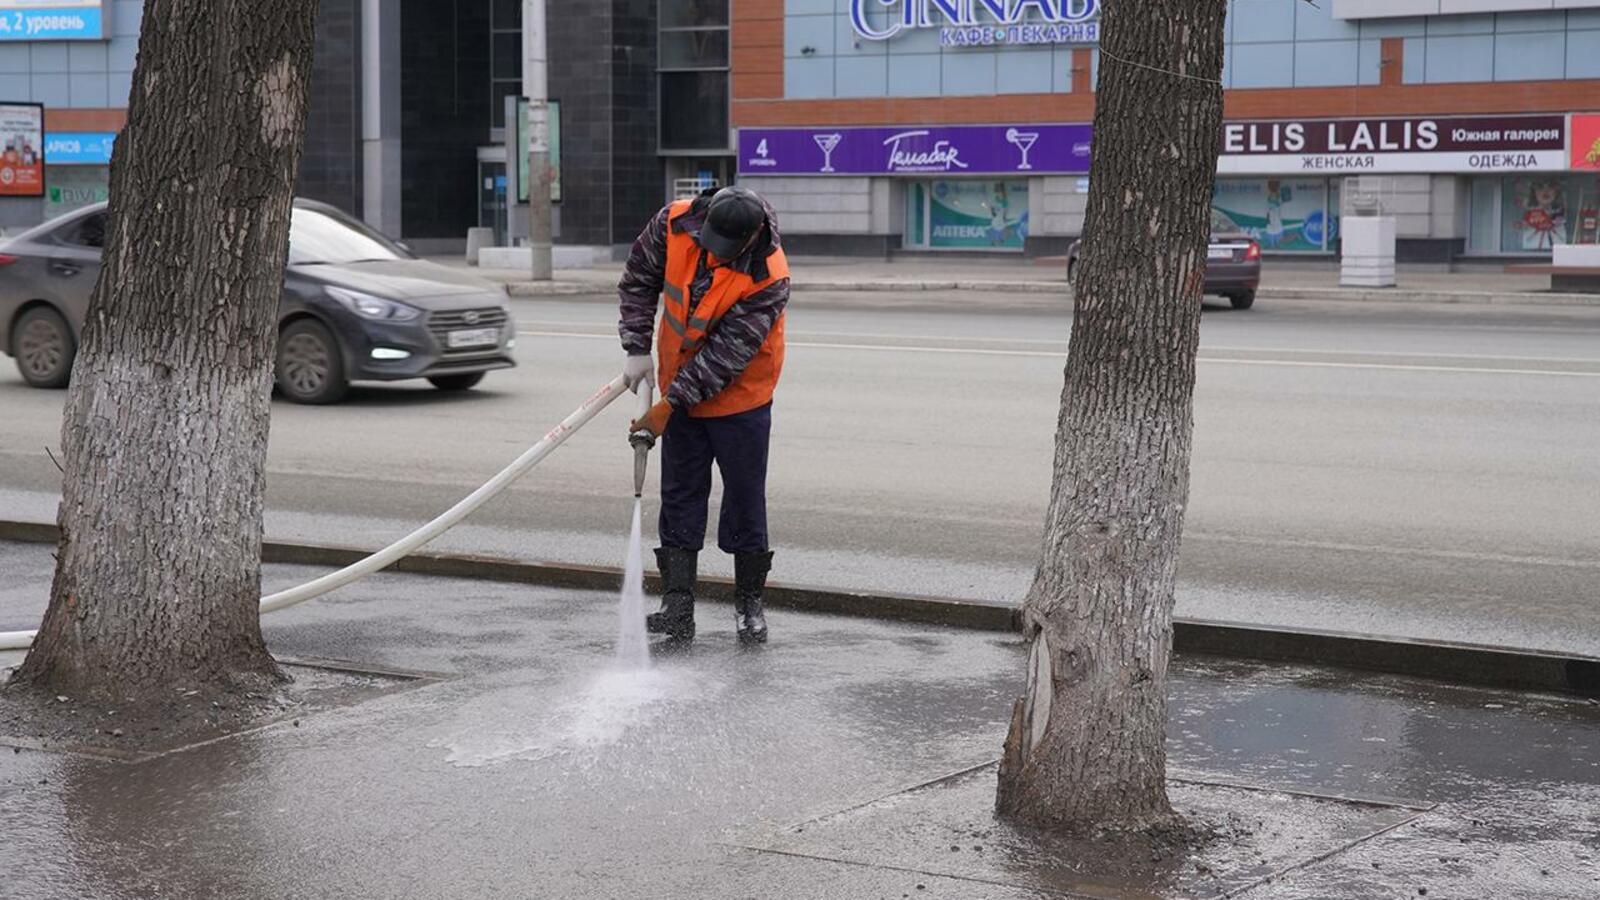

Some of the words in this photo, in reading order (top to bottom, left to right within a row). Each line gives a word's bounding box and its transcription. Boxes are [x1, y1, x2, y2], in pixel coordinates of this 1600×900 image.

[14, 11, 23, 31] 2
[26, 15, 85, 34] уровень
[849, 0, 1101, 41] CINNAB
[940, 27, 994, 46] КАФЕ
[1006, 23, 1099, 43] ПЕКАРНЯ
[1225, 123, 1305, 151] ELIS
[1327, 120, 1439, 151] LALIS
[1452, 128, 1500, 142] Южная
[1504, 129, 1559, 142] галерея
[756, 138, 768, 158] 4
[1302, 156, 1374, 169] ЖЕНСКАЯ
[1468, 154, 1537, 168] ОДЕЖДА
[932, 224, 987, 238] АПТЕКА
